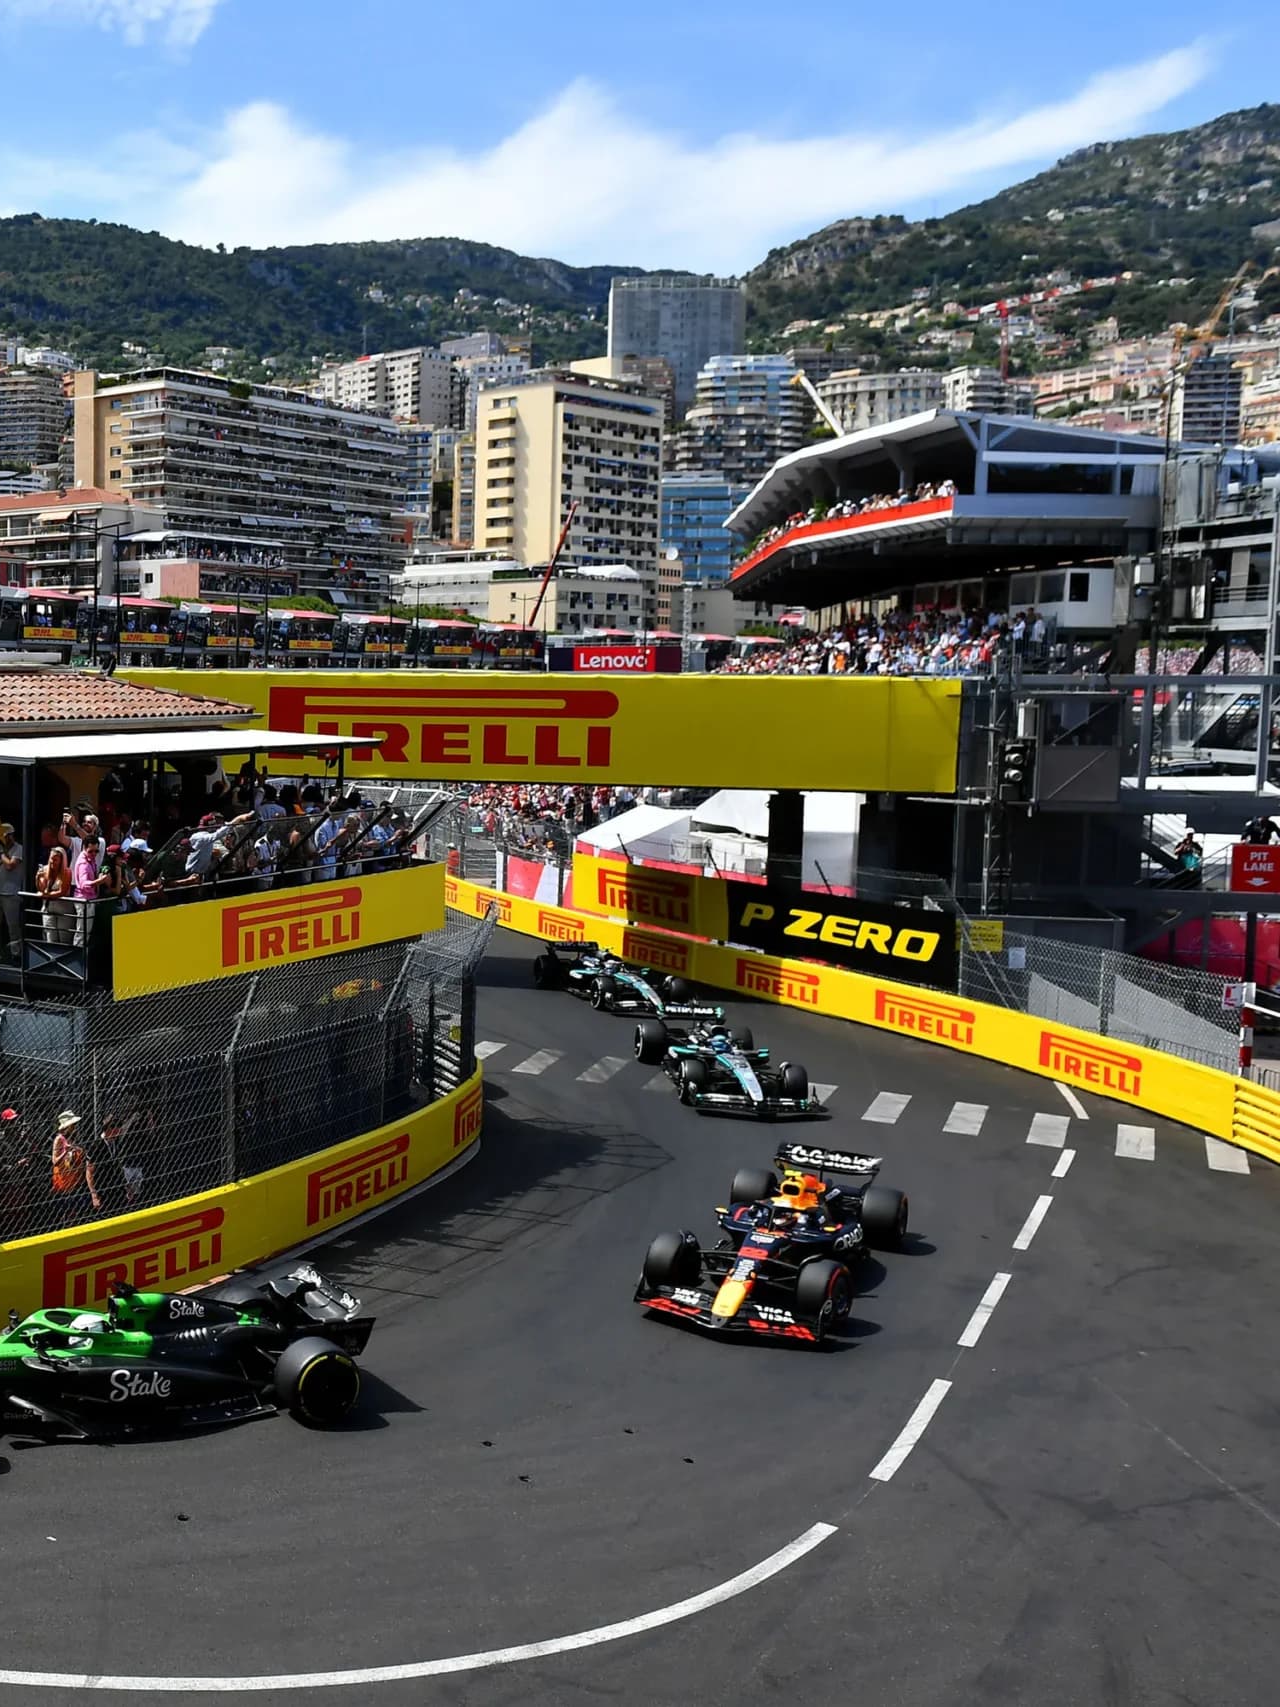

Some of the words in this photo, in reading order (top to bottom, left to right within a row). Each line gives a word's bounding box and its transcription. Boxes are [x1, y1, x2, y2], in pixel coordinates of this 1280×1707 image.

[269, 687, 619, 766] PIRELLI
[1243, 862, 1274, 872] LANE
[1250, 852, 1269, 861] PIT
[598, 868, 689, 924] PIRELLI
[222, 886, 362, 967] PIRELLI
[538, 910, 584, 942] PIRELLI
[623, 930, 688, 972] PIRELLI
[740, 903, 774, 927] P
[783, 908, 940, 962] ZERO
[736, 957, 819, 1004] PIRELLI
[874, 989, 975, 1045] PIRELLI
[1039, 1031, 1142, 1096] PIRELLI
[307, 1133, 410, 1226] PIRELLI
[43, 1206, 225, 1310] PIRELLI
[169, 1299, 206, 1319] Stake
[110, 1368, 171, 1402] Stake
